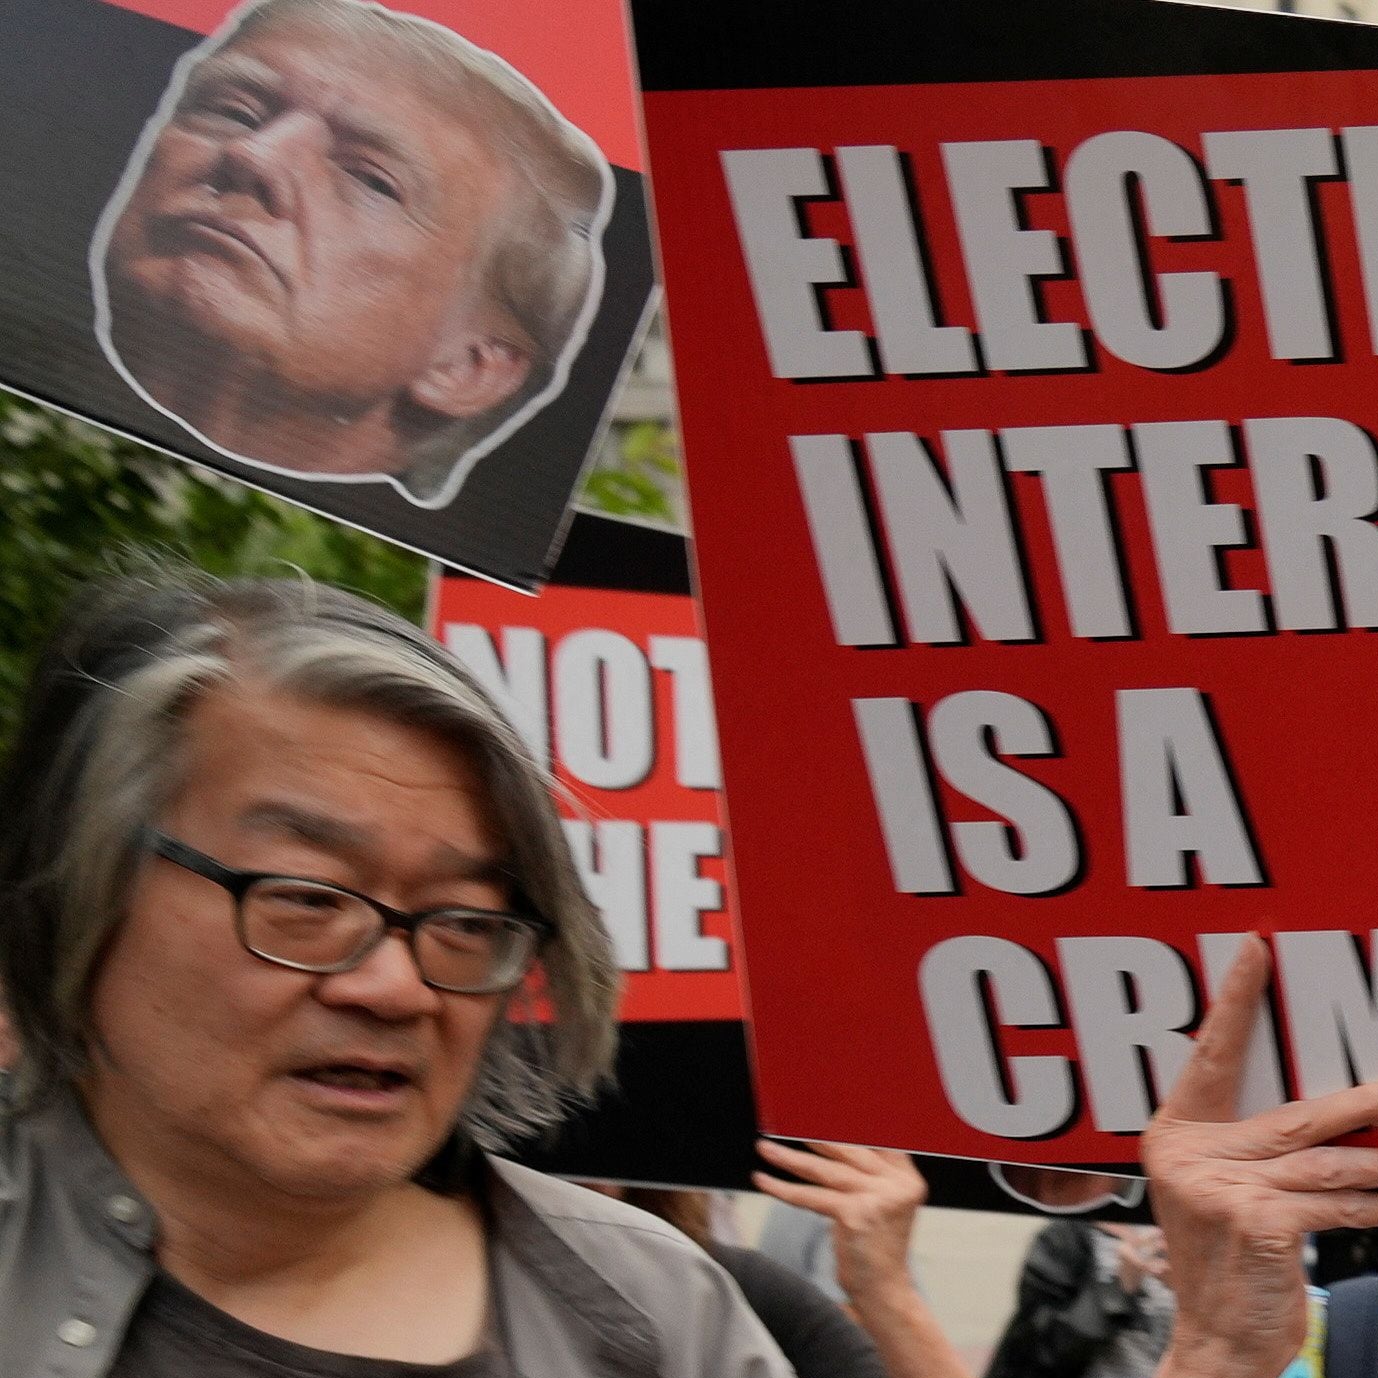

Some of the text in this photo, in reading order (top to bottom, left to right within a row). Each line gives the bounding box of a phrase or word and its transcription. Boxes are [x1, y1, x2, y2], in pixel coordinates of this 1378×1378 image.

[850, 687, 1266, 897] IS A
[565, 817, 731, 972] HE
